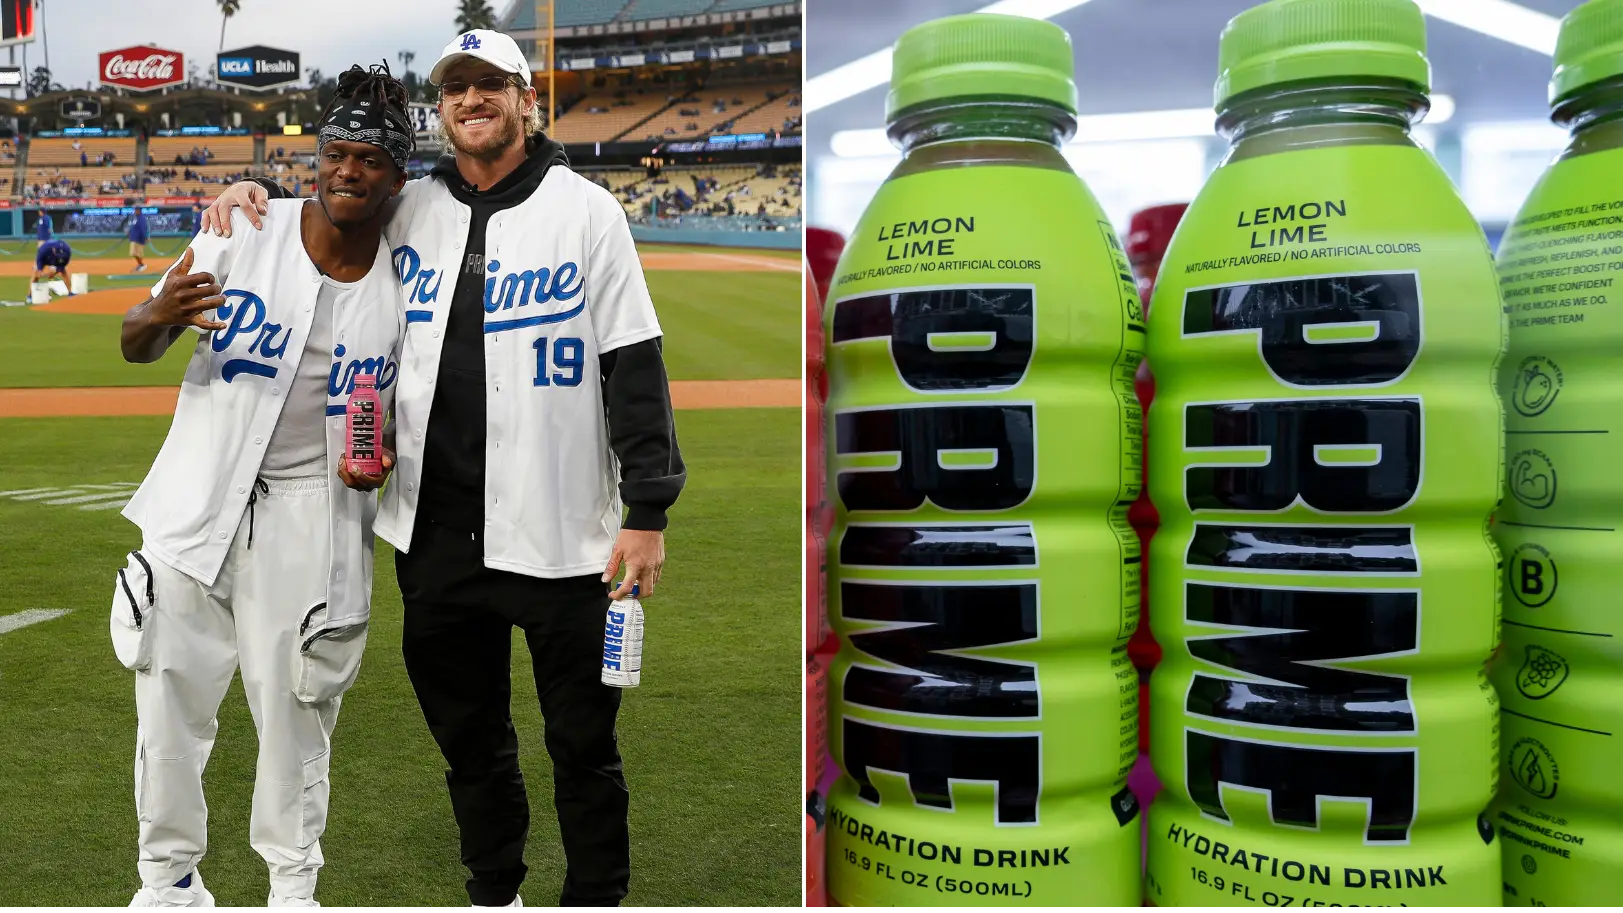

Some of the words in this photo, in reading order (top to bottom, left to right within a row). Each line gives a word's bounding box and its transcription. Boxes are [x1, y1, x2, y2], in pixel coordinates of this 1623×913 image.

[460, 33, 481, 51] LA
[221, 60, 250, 73] UCLA
[255, 59, 296, 73] Health
[1237, 199, 1347, 228] LEMON
[1591, 202, 1607, 212] THE
[1608, 200, 1623, 210] VOI
[878, 216, 975, 241] LEMON
[1250, 224, 1328, 249] LIME
[1552, 221, 1577, 232] MEETS
[886, 239, 955, 261] LIME
[1184, 257, 1228, 274] NATURALLY
[1229, 251, 1281, 267] FLAVORED
[1291, 249, 1309, 261] NO
[1310, 244, 1374, 260] ARTIFICIAL
[1375, 242, 1421, 255] COLORS
[1601, 246, 1623, 256] AND
[867, 262, 911, 279] FLAVORED
[920, 261, 936, 272] NO
[938, 259, 995, 271] ARTIFICIAL
[997, 259, 1042, 270] COLORS
[1536, 266, 1573, 278] PERFECT
[1573, 263, 1606, 275] BOOST
[1558, 278, 1614, 292] CONFIDENT
[1559, 298, 1571, 307] AS
[1573, 296, 1587, 306] WE
[1590, 295, 1608, 305] DO.
[1530, 316, 1556, 327] PRIME
[1558, 313, 1584, 324] TEAM
[532, 336, 585, 388] 19
[352, 401, 375, 460] PRIME
[831, 282, 1043, 828] PRIME
[1180, 269, 1425, 846] PRIME
[1520, 558, 1544, 595] B
[602, 609, 625, 671] PRIME
[829, 804, 962, 865] HYDRATION
[973, 846, 1072, 869] DRINK
[1167, 822, 1332, 887] HYDRATION
[1343, 864, 1448, 890] DRINK
[843, 847, 872, 872] 16.9
[876, 862, 896, 881] FL
[901, 870, 929, 888] OZ
[935, 875, 1033, 899] (500ML)
[1191, 866, 1226, 891] 16.9
[1231, 882, 1256, 902] FL
[1261, 891, 1295, 908] OZ
